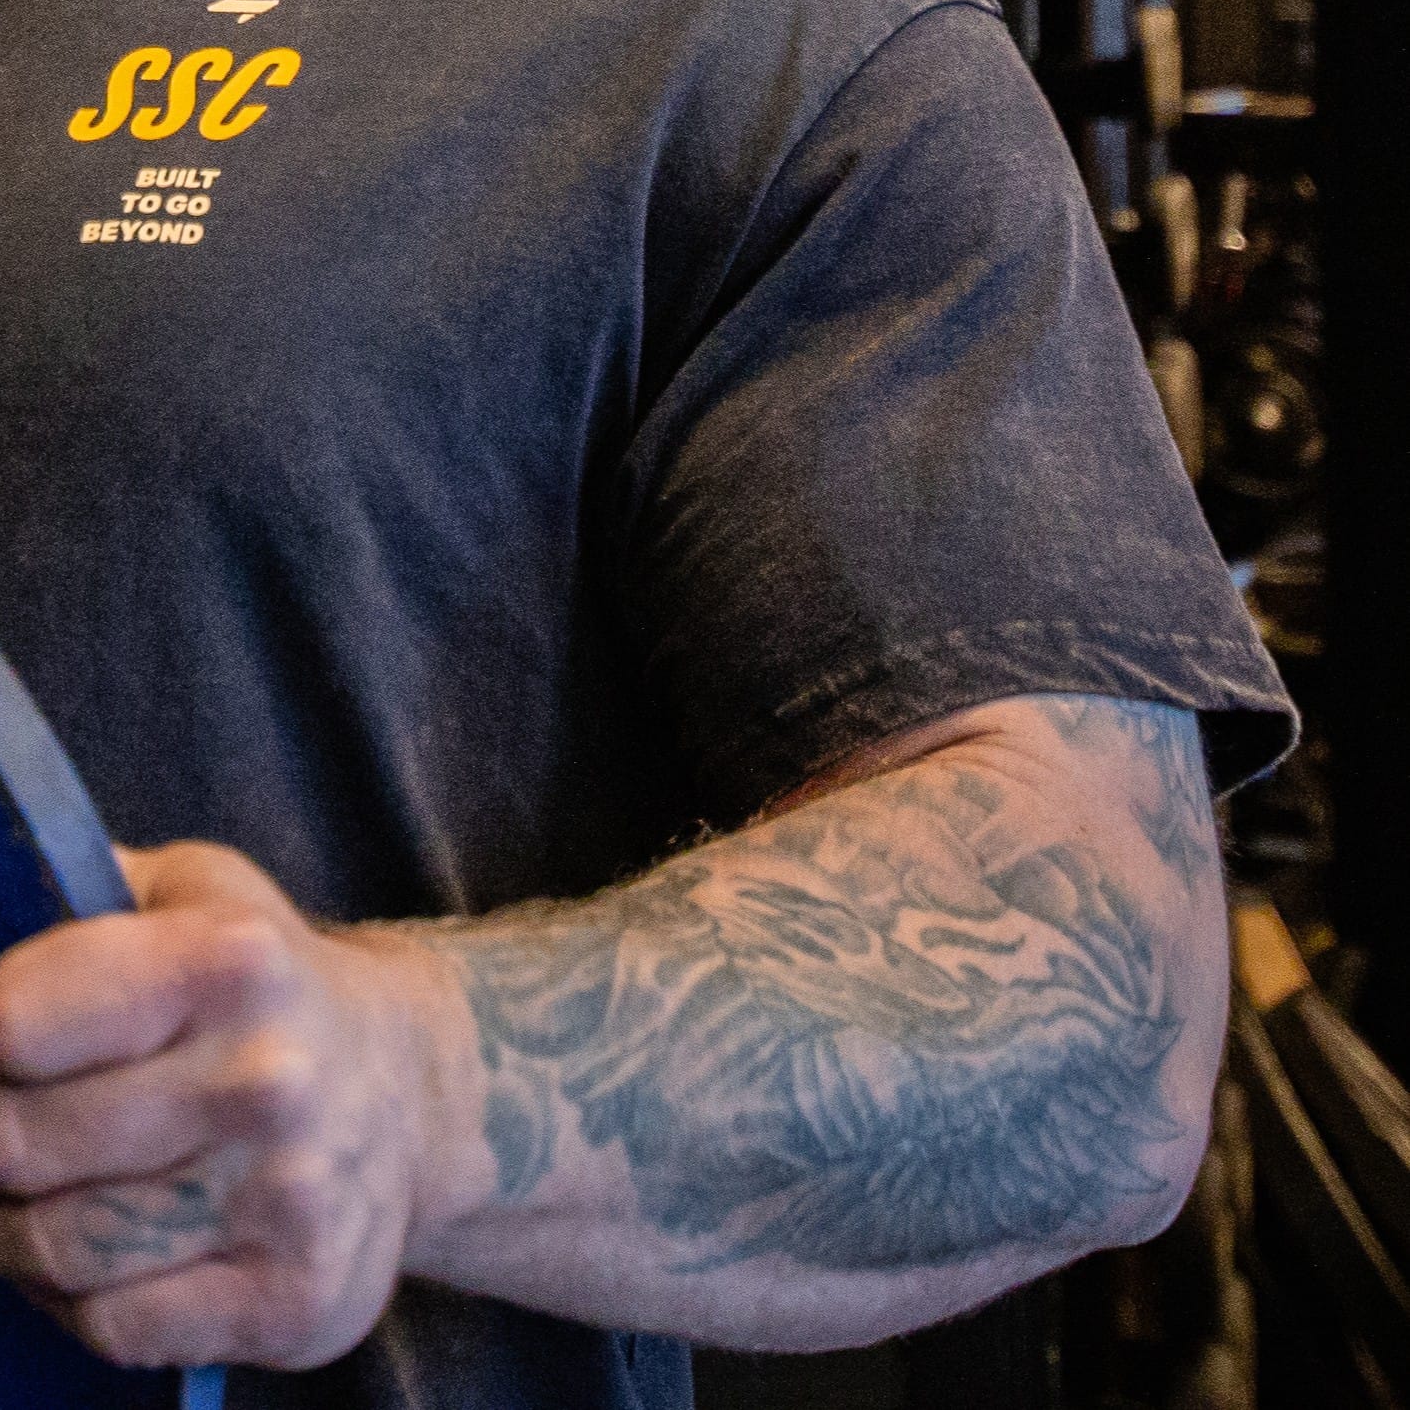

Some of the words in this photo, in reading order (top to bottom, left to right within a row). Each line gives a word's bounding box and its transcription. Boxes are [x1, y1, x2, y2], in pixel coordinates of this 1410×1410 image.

[67, 46, 301, 142] SSC
[135, 167, 221, 189] BUILT
[121, 192, 163, 214] TO
[165, 193, 211, 216] GO
[79, 219, 205, 245] BEYOND
